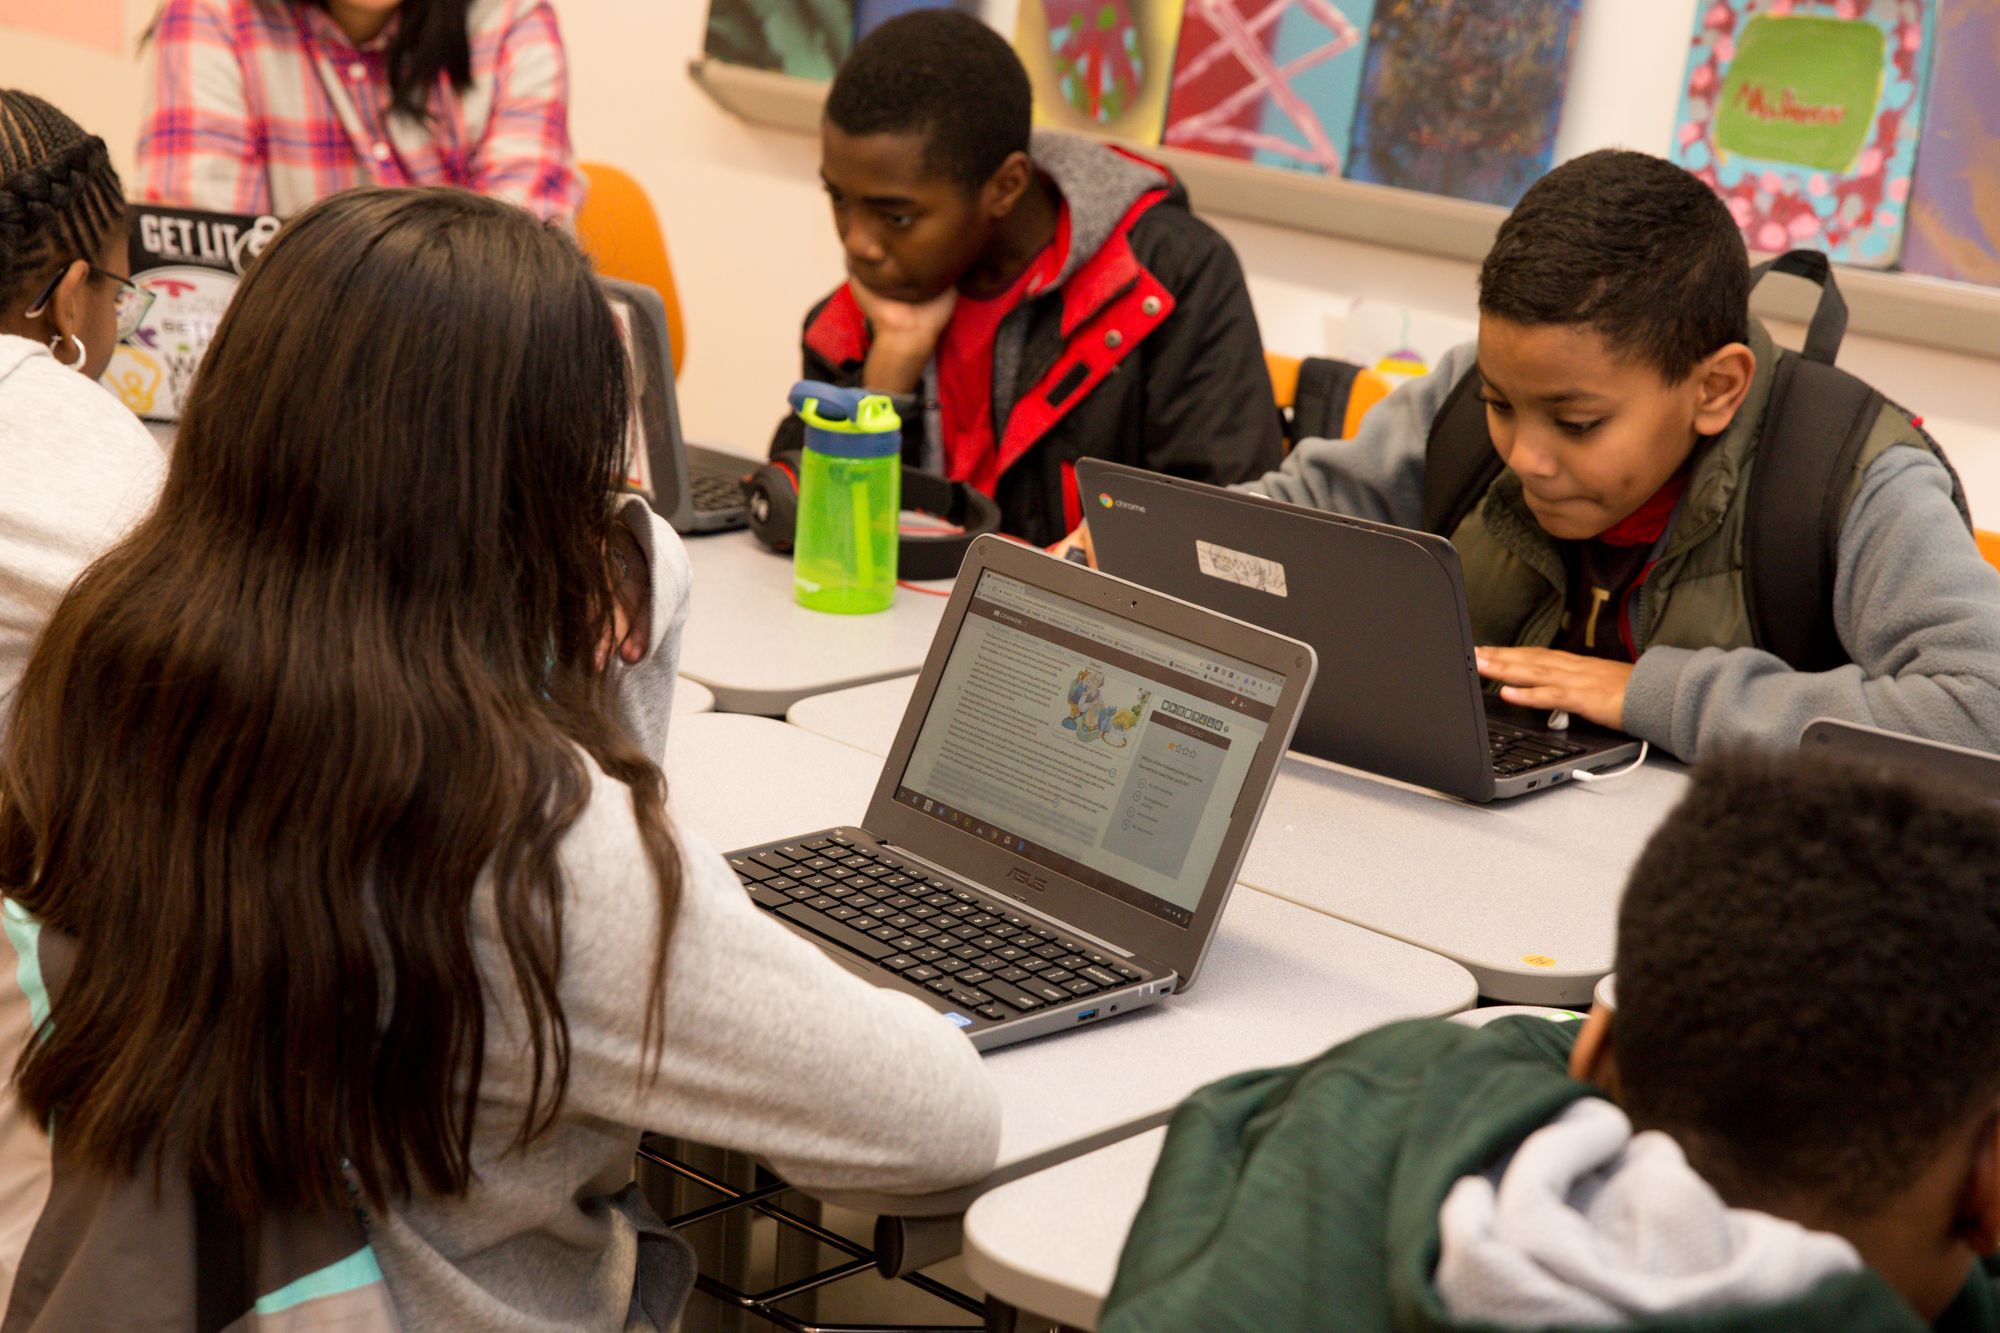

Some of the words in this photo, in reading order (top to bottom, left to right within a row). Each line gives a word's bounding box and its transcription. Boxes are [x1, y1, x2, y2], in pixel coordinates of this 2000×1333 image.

[140, 214, 193, 257] GET
[198, 221, 239, 265] LIT
[1114, 498, 1146, 513] chrome
[1006, 867, 1048, 892] ASUS
